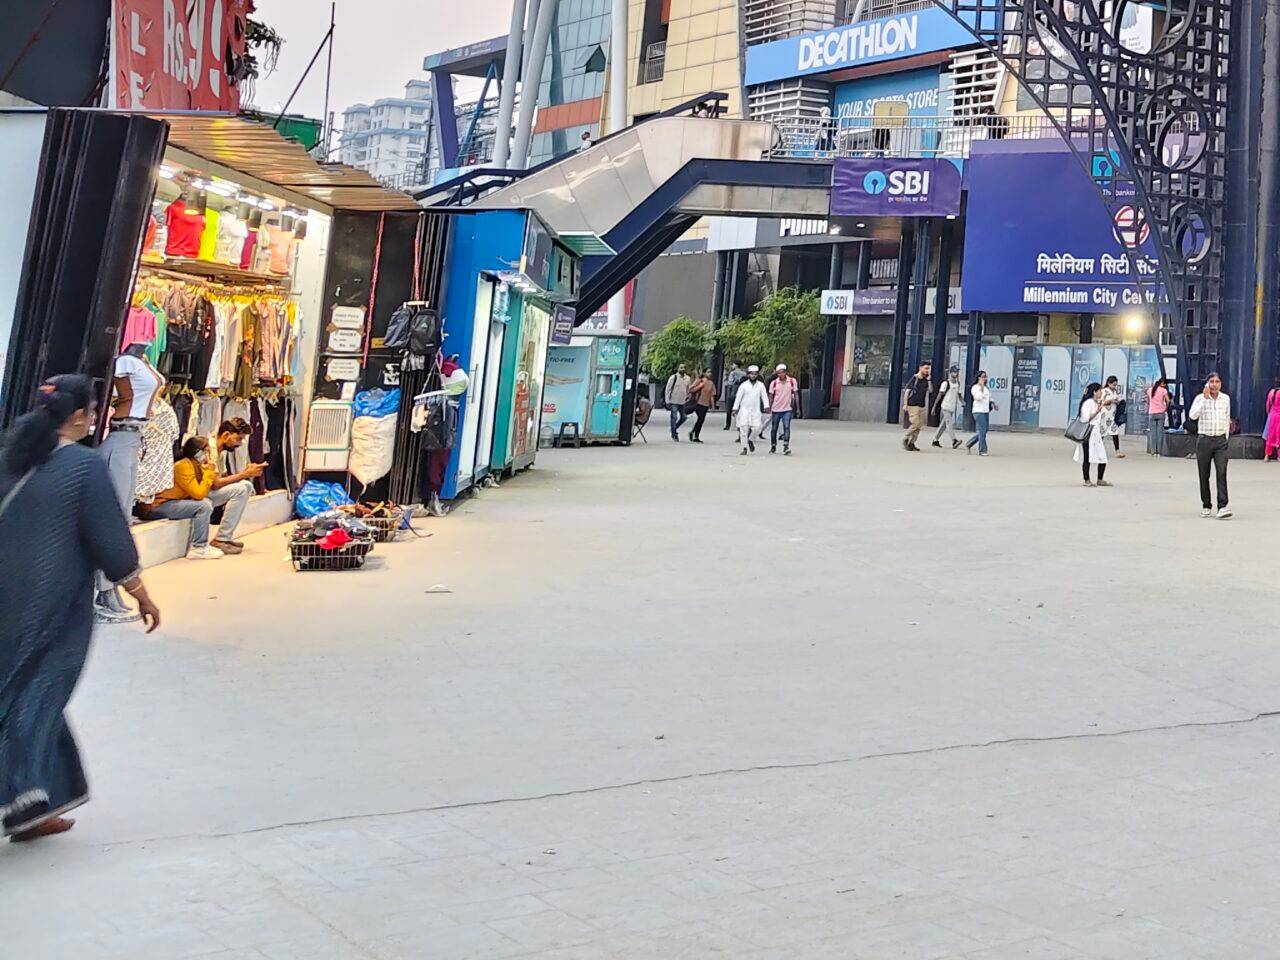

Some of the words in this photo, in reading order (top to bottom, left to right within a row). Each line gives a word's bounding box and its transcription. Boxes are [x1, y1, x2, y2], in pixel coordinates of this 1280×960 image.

[798, 15, 918, 71] DECATHLON
[838, 99, 863, 119] YOUR
[907, 88, 938, 109] STORE
[888, 170, 930, 195] SBI
[1037, 253, 1095, 274] मिलेनियम
[1101, 253, 1130, 274] सिटी
[834, 296, 848, 310] SBI
[947, 295, 956, 308] BI
[1024, 287, 1088, 303] Millennium
[1093, 288, 1118, 307] City
[996, 377, 1008, 389] SBI
[1053, 379, 1065, 391] SBI
